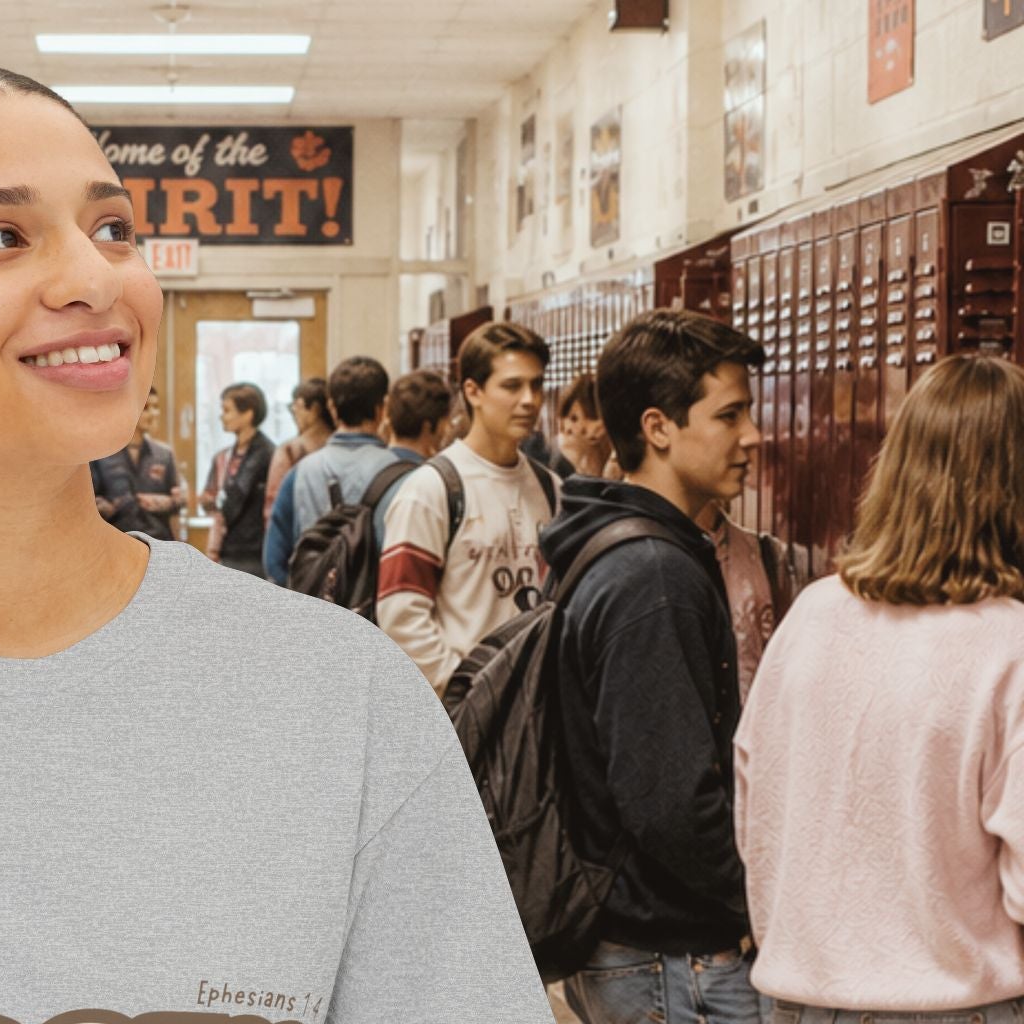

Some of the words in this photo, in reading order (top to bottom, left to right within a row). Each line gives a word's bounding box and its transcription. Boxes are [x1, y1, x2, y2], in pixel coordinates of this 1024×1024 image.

[171, 133, 211, 176] of
[214, 131, 269, 166] the
[122, 177, 343, 237] IRIT!
[197, 980, 296, 1012] Ephesians
